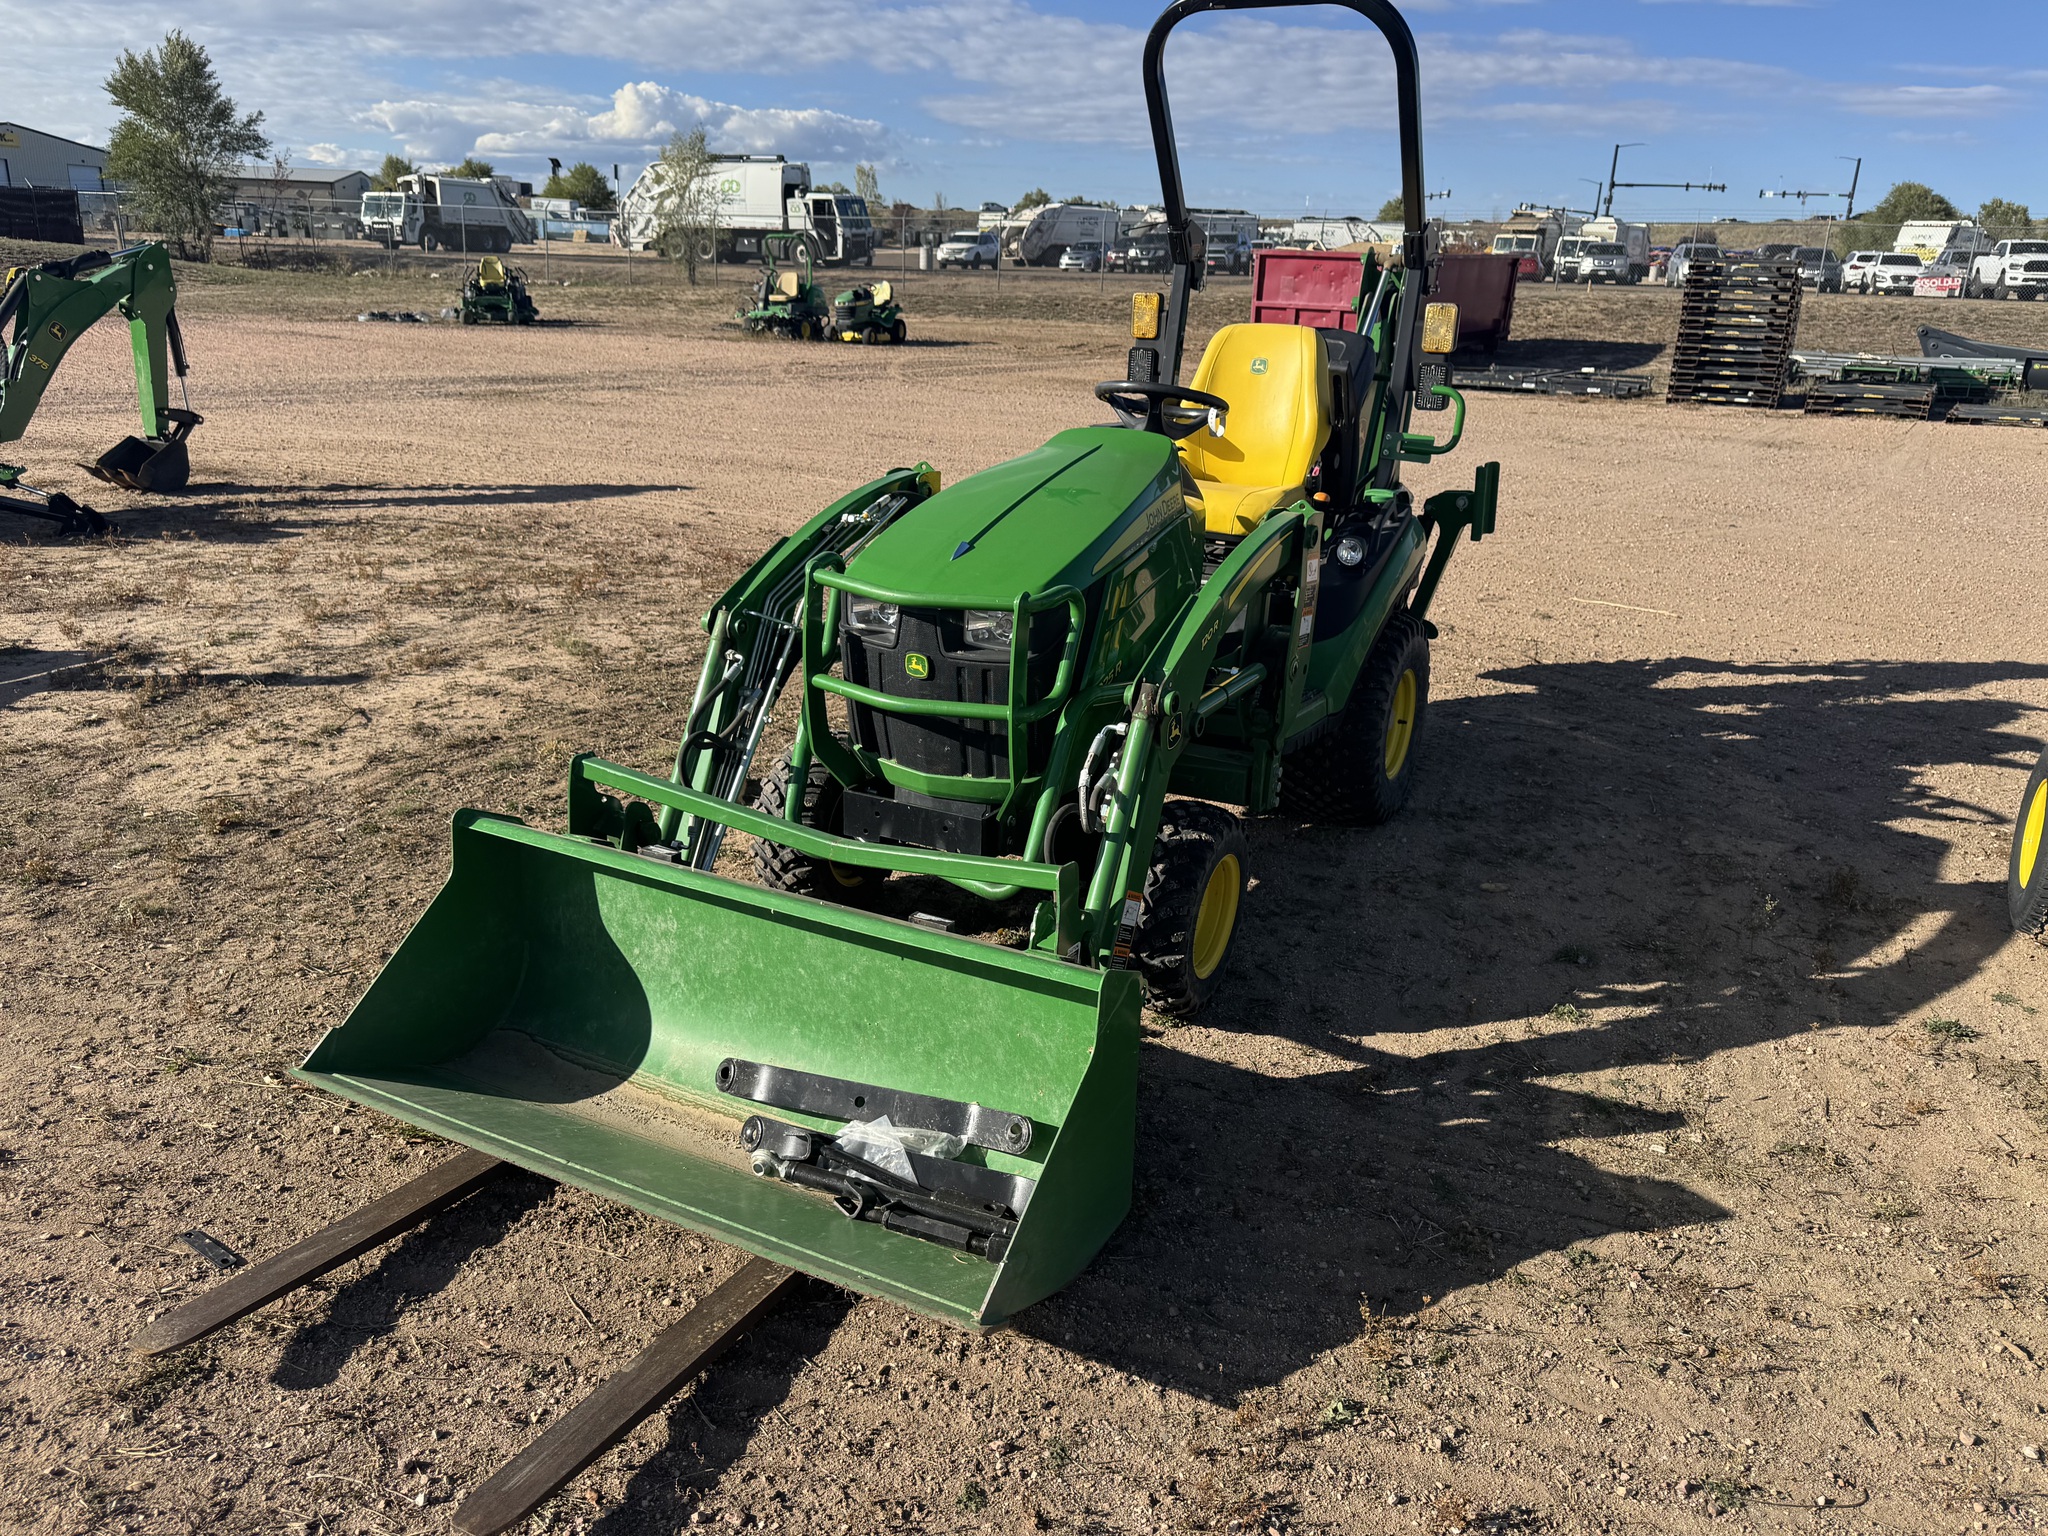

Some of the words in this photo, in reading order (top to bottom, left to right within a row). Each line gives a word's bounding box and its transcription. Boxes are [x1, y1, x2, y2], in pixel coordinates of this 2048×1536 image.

[29, 354, 50, 370] 375
[1145, 507, 1163, 531] JOHN
[1161, 493, 1181, 516] DEERE
